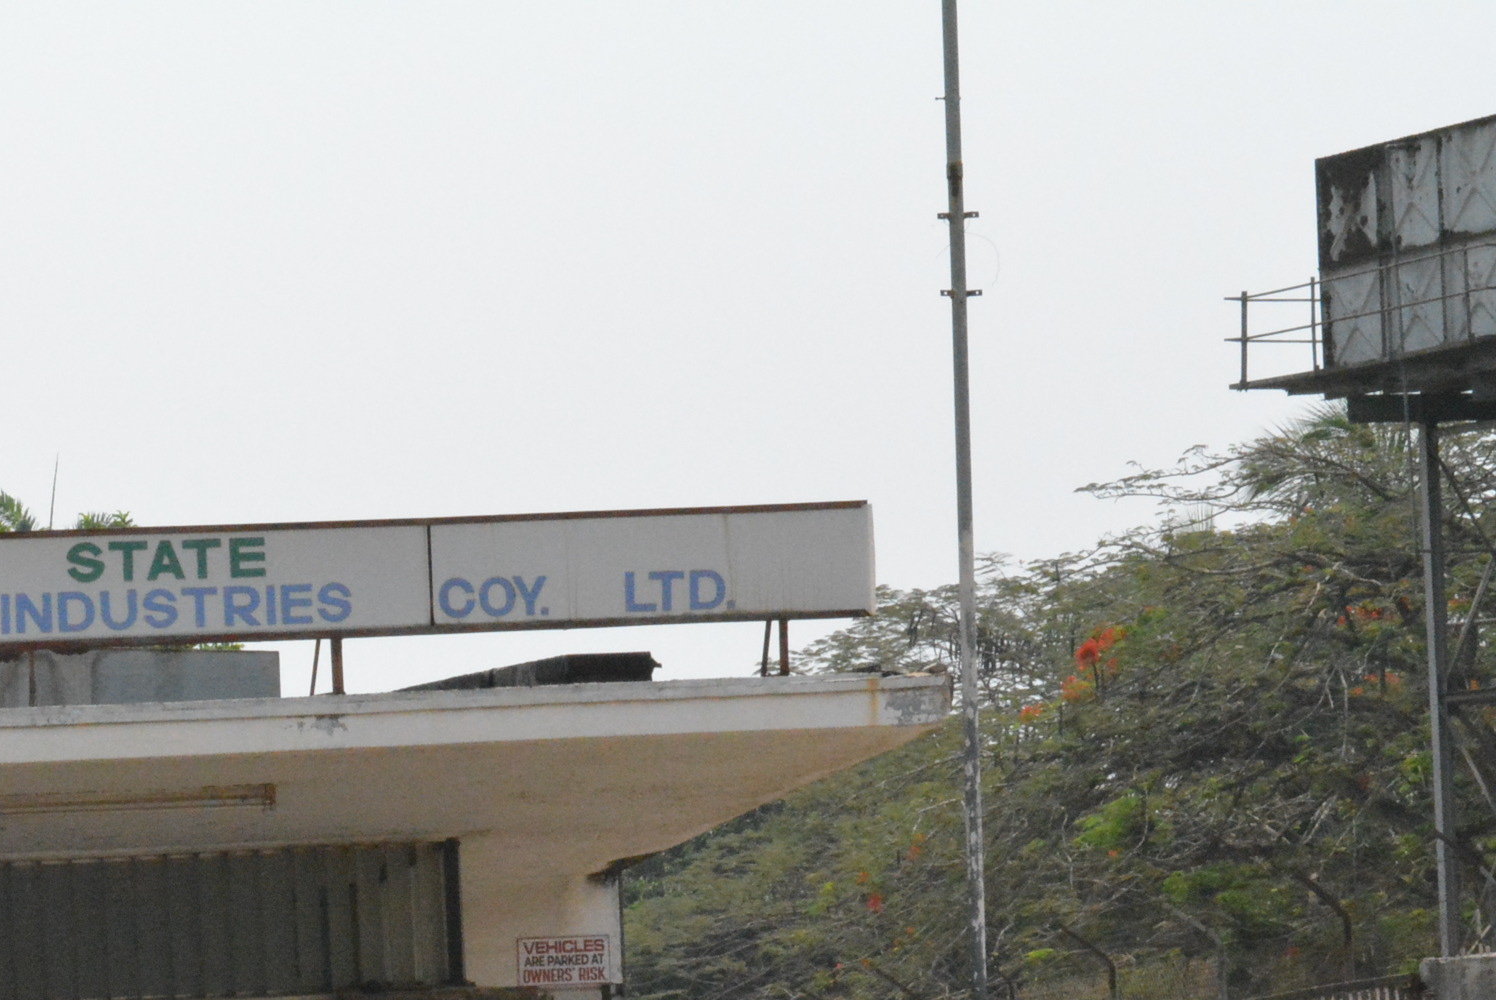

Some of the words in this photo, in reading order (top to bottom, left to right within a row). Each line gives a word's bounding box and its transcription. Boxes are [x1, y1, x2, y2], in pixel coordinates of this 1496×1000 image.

[65, 536, 267, 583] STATE
[0, 582, 353, 635] INDUSTRIES
[437, 575, 550, 618] COY.
[623, 569, 736, 613] LTD.
[523, 939, 605, 954] VEHICLES
[524, 955, 545, 967] ARE
[547, 953, 589, 966] PARKED
[592, 953, 604, 965] AT
[523, 967, 575, 983] OWNERS'
[578, 966, 606, 981] RISK
